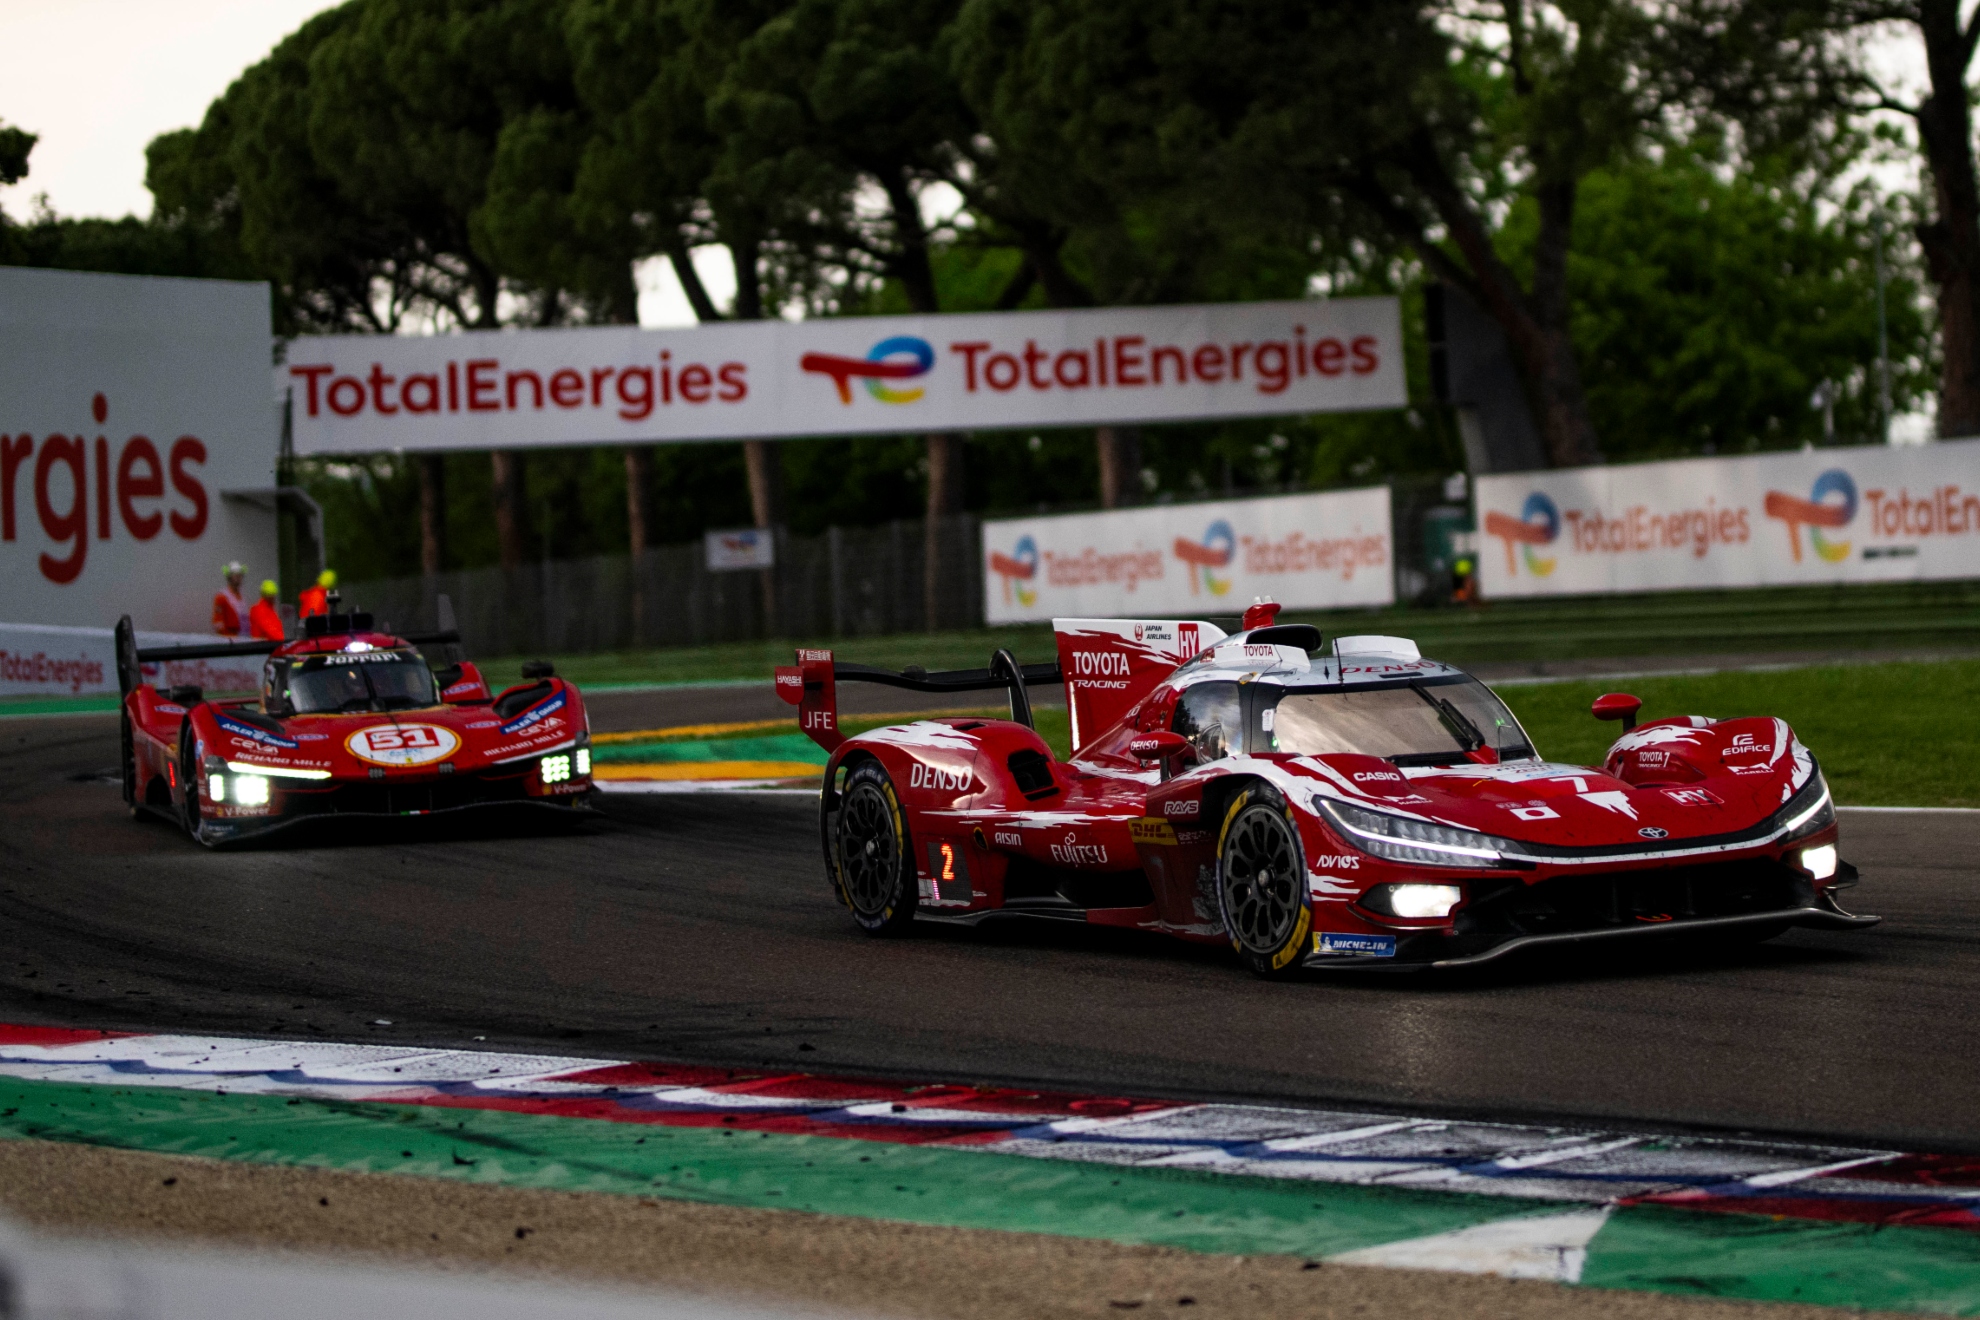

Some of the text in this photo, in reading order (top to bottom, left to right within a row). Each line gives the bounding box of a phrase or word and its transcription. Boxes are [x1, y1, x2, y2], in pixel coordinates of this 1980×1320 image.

[950, 326, 1379, 395] TotalEnergies
[290, 351, 748, 420] TotalEnergies
[0, 391, 208, 585] rgies
[1565, 497, 1749, 560] TotalEnergies
[1241, 525, 1386, 581] TotalEnergies
[1180, 631, 1198, 659] HY
[1243, 645, 1274, 657] TOYOTA
[324, 651, 402, 665] Ferrari
[1072, 651, 1130, 675] TOYOTA
[1340, 661, 1436, 674] DENSO
[1074, 679, 1131, 689] RACING
[805, 711, 833, 729] JFE
[370, 730, 436, 750] 51
[1130, 740, 1158, 750] DENSO
[1639, 751, 1662, 762] TOYOTA
[1722, 744, 1771, 756] EDIFICE
[1663, 752, 1670, 768] 7
[910, 763, 973, 791] DENSO
[1353, 771, 1401, 782] CASIO
[1549, 776, 1589, 793] 7
[1164, 800, 1199, 815] RAYS
[1132, 823, 1167, 838] DHL
[995, 832, 1022, 846] AISIN
[941, 843, 955, 880] 2
[1050, 844, 1108, 867] FUJITSU
[1333, 940, 1387, 950] MICHELIN
